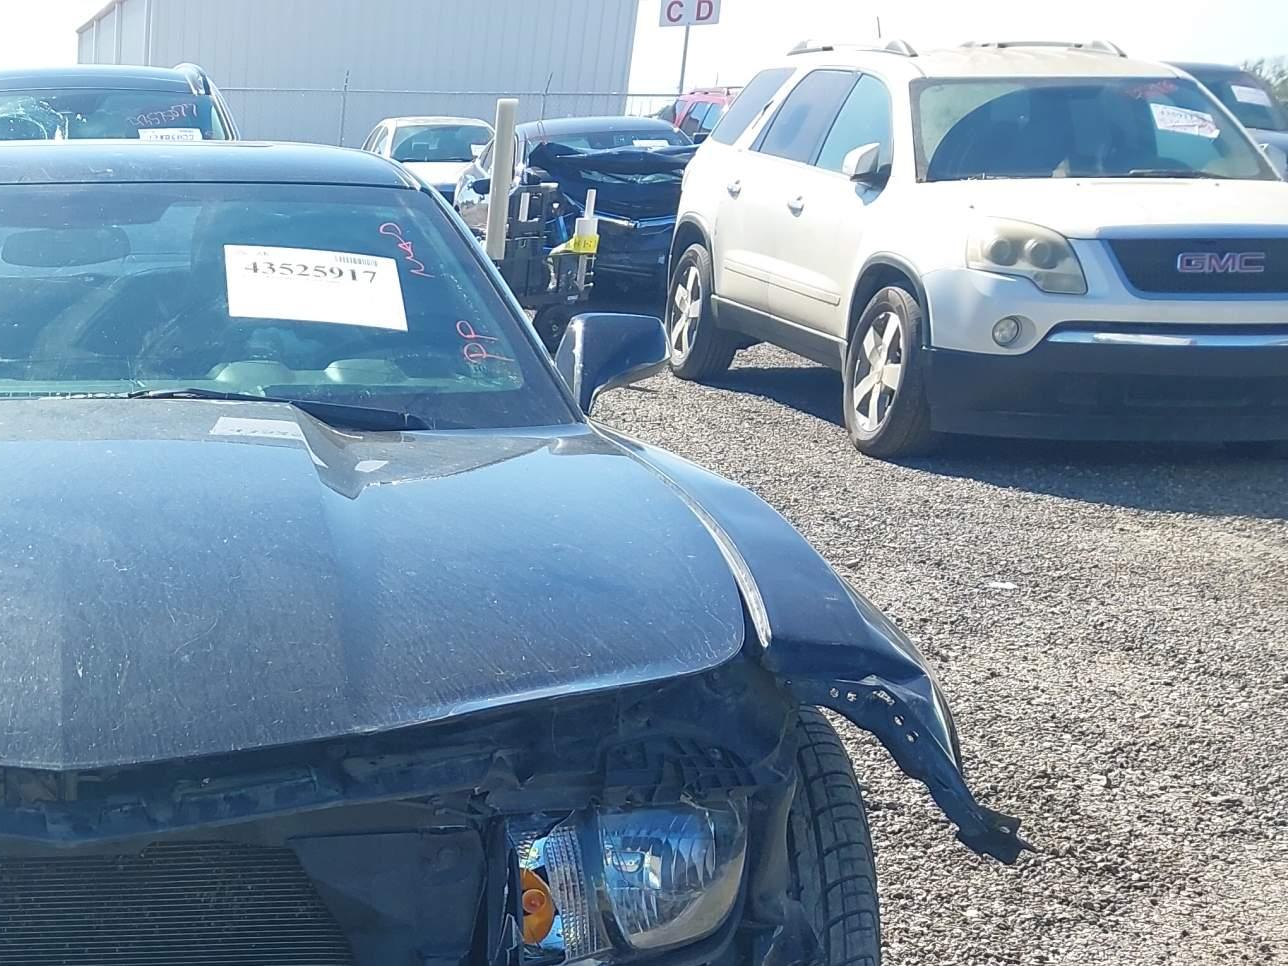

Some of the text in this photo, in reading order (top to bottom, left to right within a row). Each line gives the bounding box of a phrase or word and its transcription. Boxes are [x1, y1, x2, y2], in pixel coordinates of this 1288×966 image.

[666, 0, 714, 22] C D
[244, 261, 377, 283] 43525917
[1176, 252, 1265, 273] GMC
